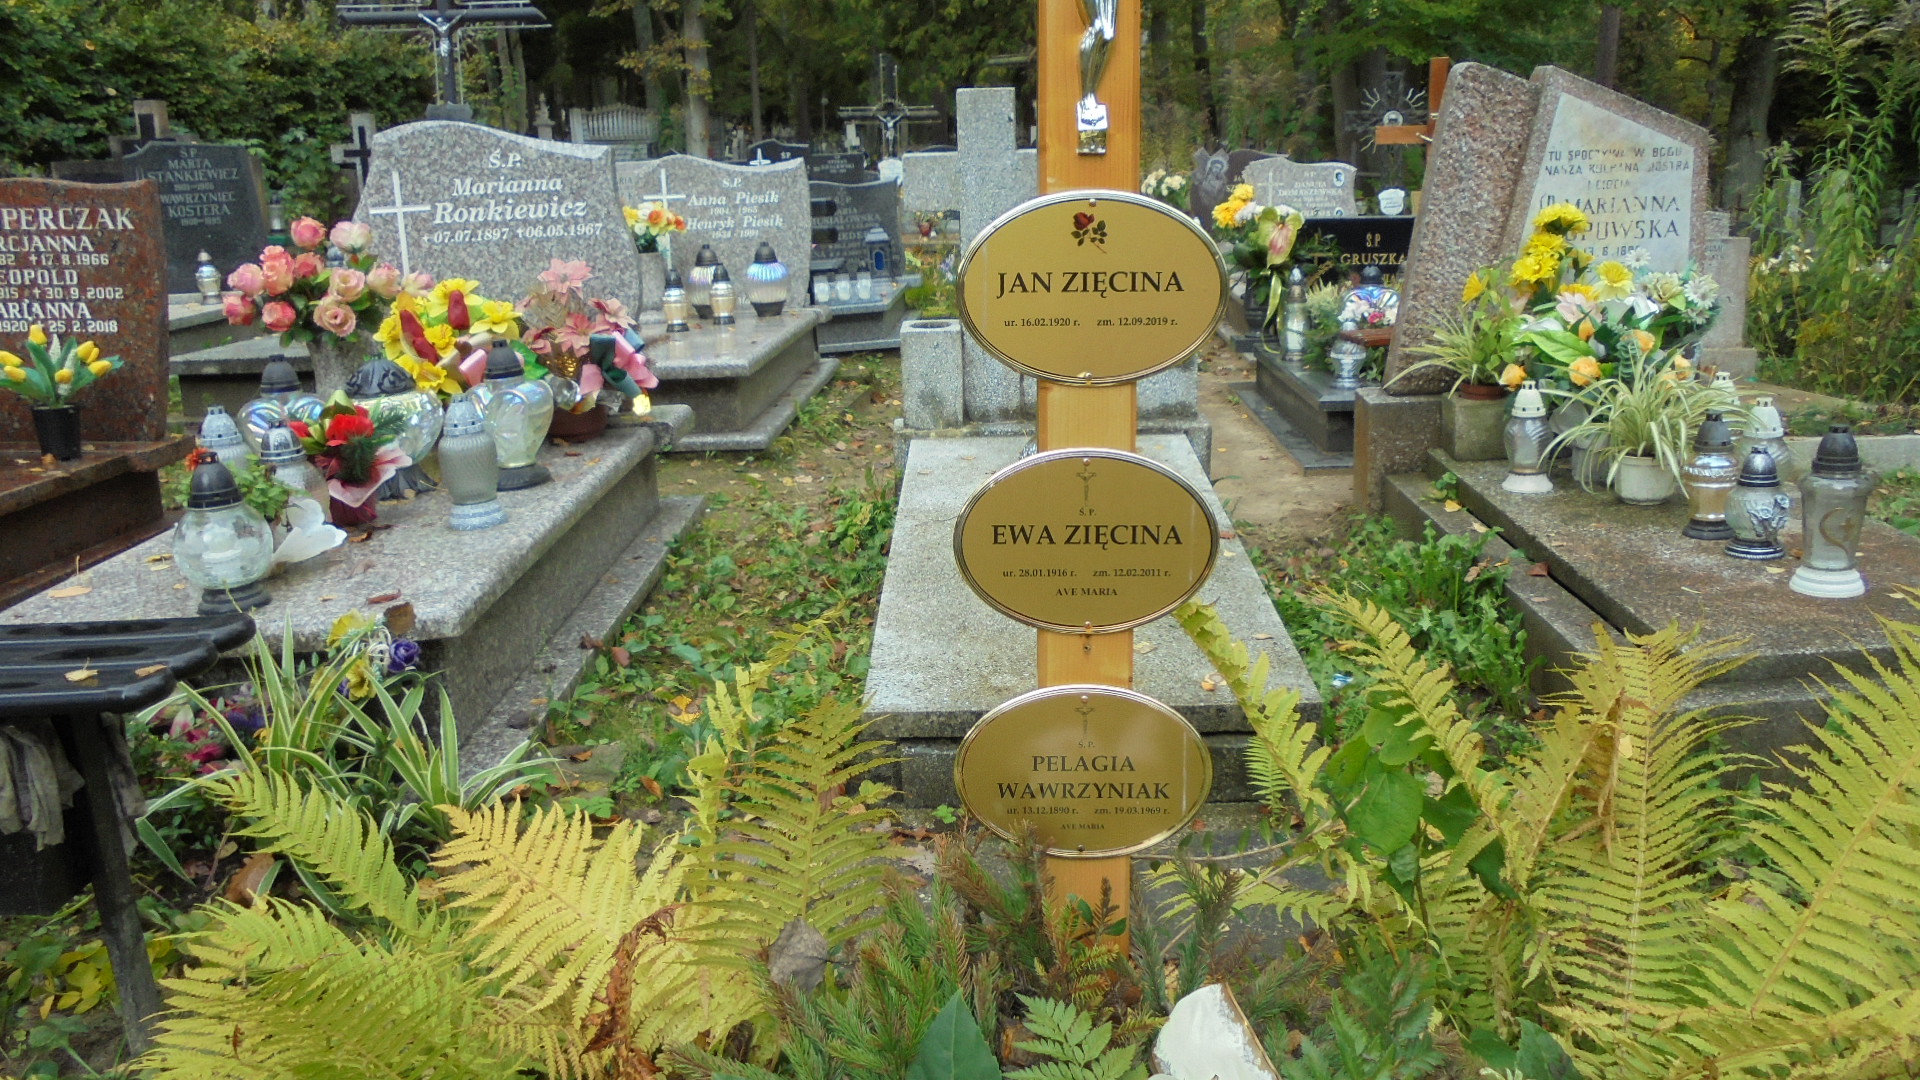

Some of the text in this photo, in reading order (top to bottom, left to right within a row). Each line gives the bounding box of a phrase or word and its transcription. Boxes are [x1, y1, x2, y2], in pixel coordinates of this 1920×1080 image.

[1548, 150, 1562, 161] TU
[147, 168, 239, 182] STANKIEWICZ
[452, 176, 563, 196] Marianna
[688, 191, 779, 206] Anna Piesik
[168, 204, 231, 218] KOSTERA
[433, 195, 587, 224] Ronkiewicz
[687, 214, 783, 231] Henryk Piesik
[1340, 252, 1407, 265] GRUSZKA
[997, 271, 1184, 299] JAN ZIĘCINA
[1004, 317, 1178, 327] ur. 16.02.1920 r. zm. 12.09.2019 r.
[992, 524, 1183, 550] EWA ZIĘCINA
[1019, 569, 1068, 577] 28.01.1916
[1113, 569, 1161, 577] 12.02.2011
[1055, 588, 1118, 596] AVE MARIA
[1032, 755, 1136, 772] PELAGIA
[997, 782, 1170, 799] WAWRZYNIAK
[1007, 807, 1019, 815] ur.
[1022, 806, 1070, 815] 13.12.1890
[1114, 806, 1161, 815] 19.03.1969
[1163, 807, 1170, 815] r.
